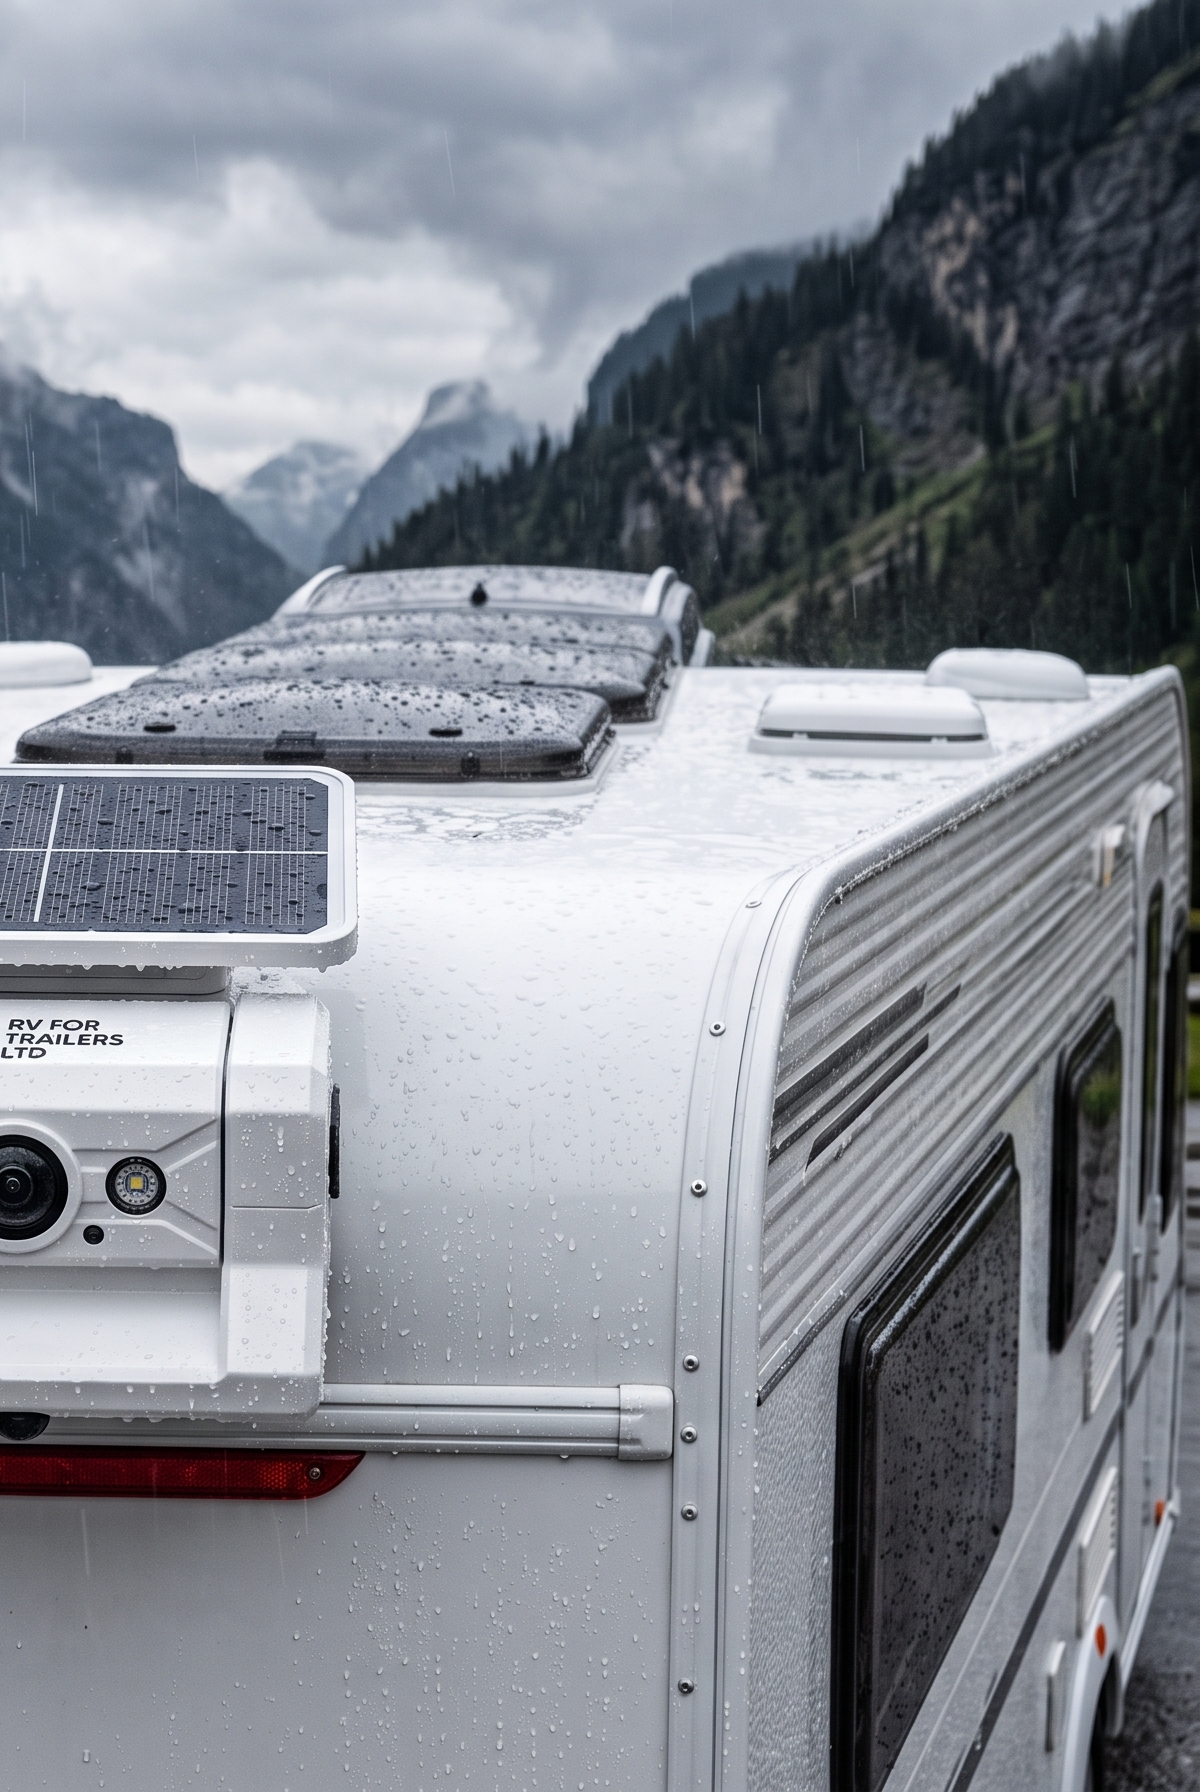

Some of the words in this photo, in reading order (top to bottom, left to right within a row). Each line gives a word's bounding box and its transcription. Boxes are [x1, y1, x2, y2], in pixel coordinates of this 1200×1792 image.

[8, 1018, 44, 1031] RV
[49, 1018, 100, 1032] FOR
[5, 1033, 124, 1046] TRAILERS
[0, 1046, 47, 1059] LTD
